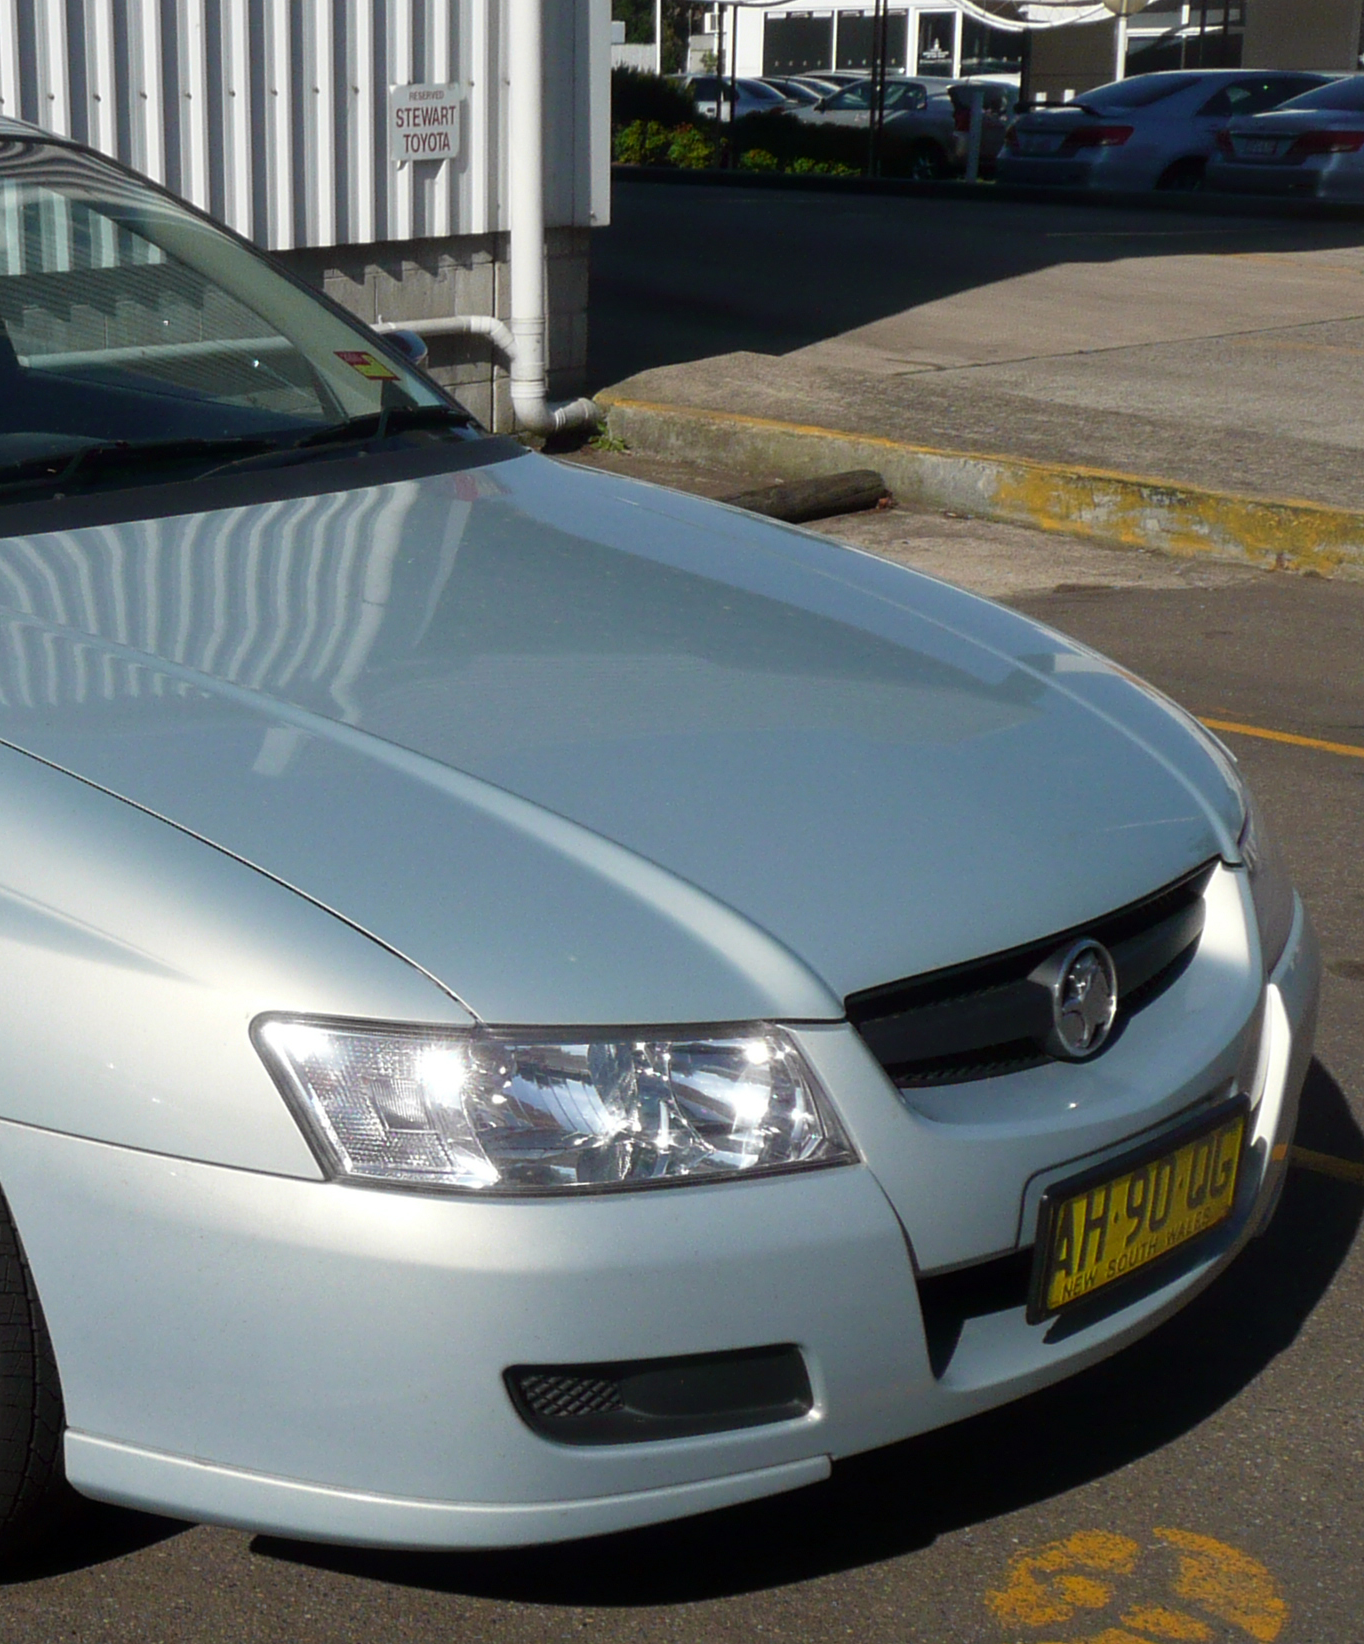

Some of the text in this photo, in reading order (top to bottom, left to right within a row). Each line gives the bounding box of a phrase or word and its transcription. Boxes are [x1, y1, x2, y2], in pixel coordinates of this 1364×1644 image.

[409, 91, 444, 101] RESERVED
[396, 106, 456, 128] STEWART
[403, 132, 450, 153] TOYOTA
[1062, 1268, 1097, 1302] NEW
[1107, 1235, 1158, 1278] SOUTH
